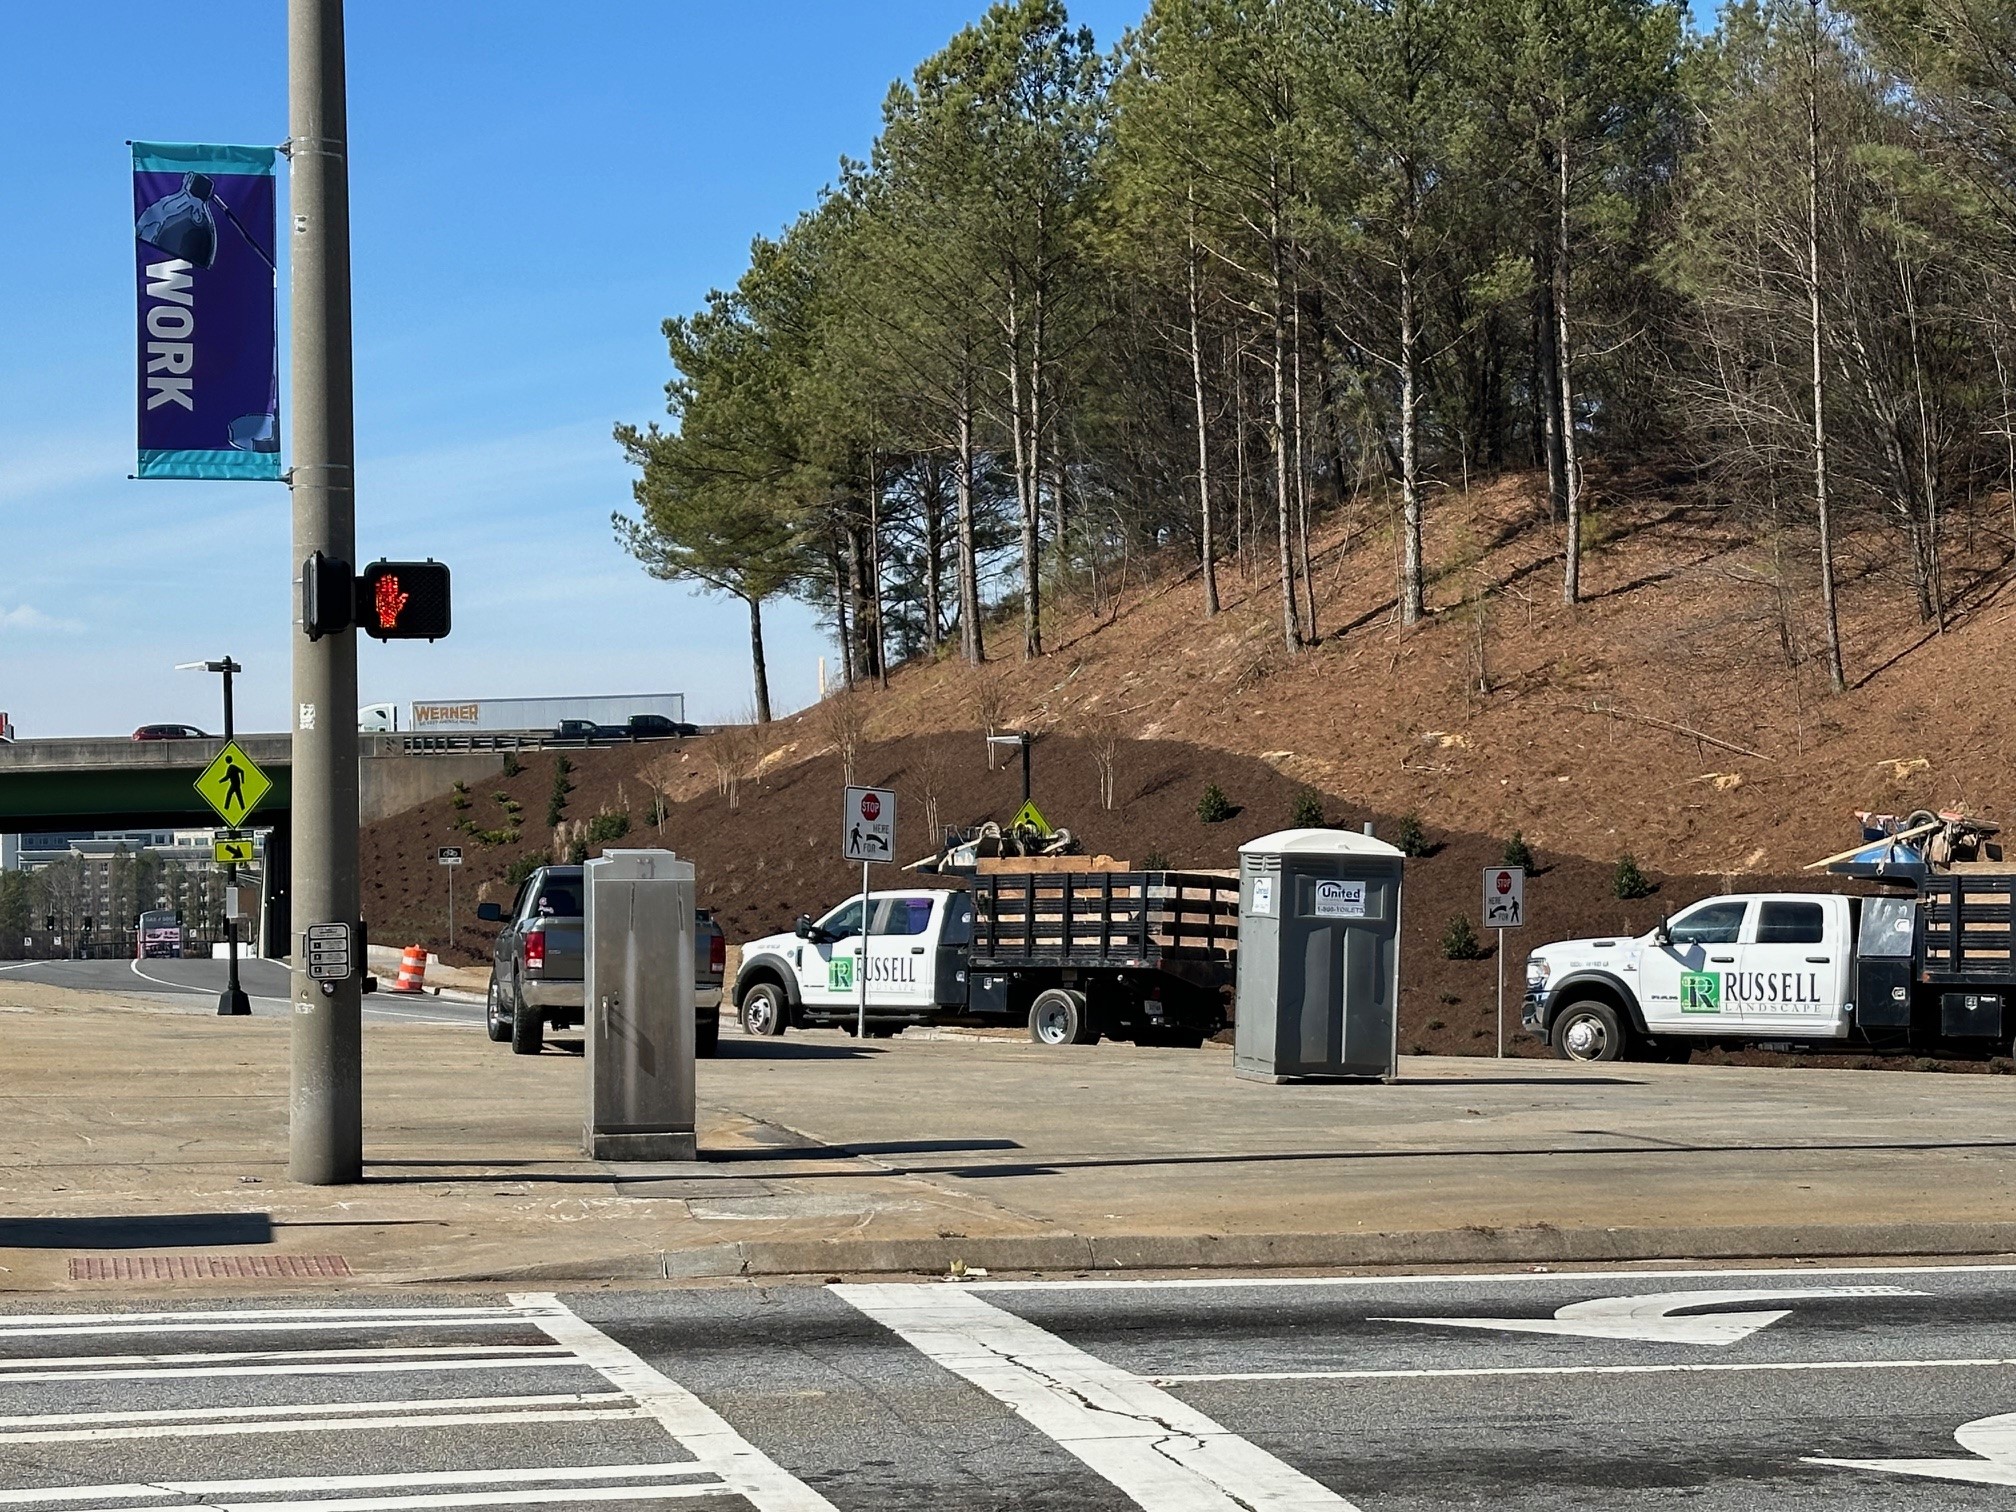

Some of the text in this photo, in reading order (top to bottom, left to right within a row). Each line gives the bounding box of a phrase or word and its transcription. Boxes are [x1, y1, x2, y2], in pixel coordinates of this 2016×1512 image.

[146, 258, 194, 412] WORK
[414, 704, 479, 721] WERNER
[862, 801, 880, 813] STOP
[873, 823, 890, 835] HERE
[863, 842, 876, 854] FOR
[1322, 887, 1361, 899] United
[1725, 972, 1821, 1002] RUSSELL
[1725, 1003, 1822, 1013] LANDSCAPE
